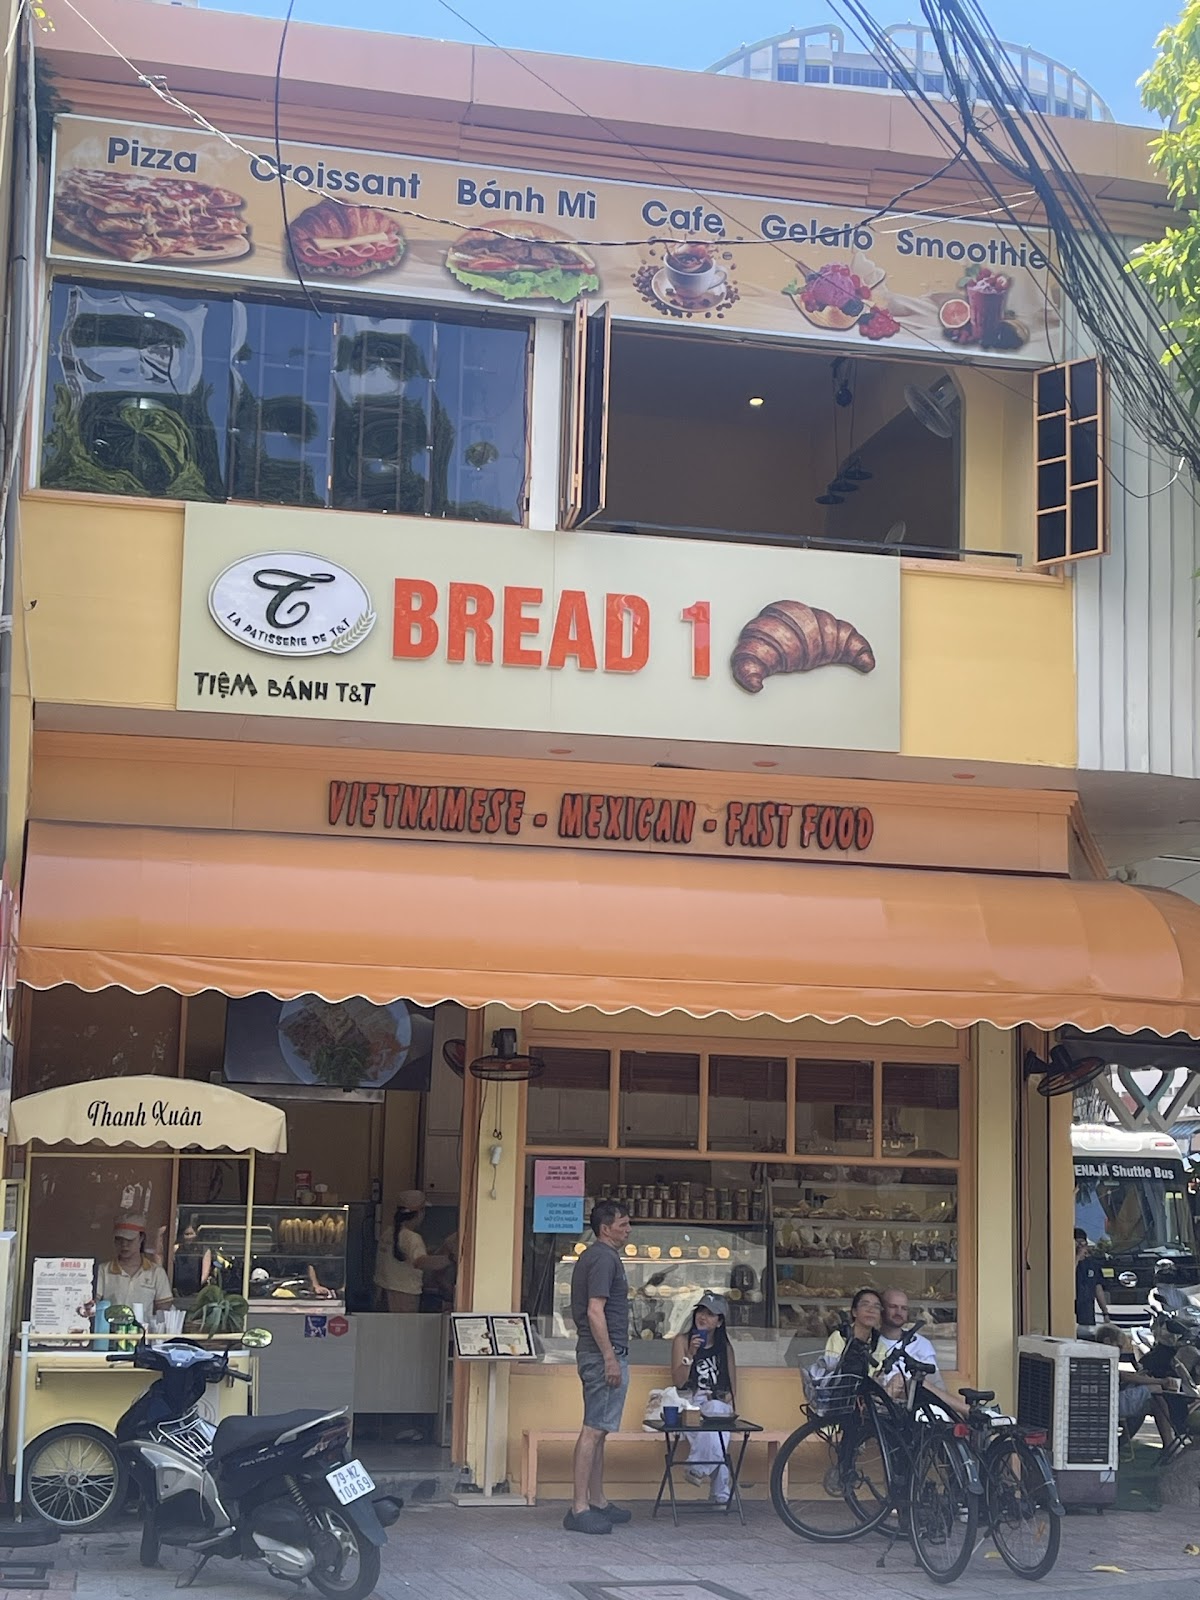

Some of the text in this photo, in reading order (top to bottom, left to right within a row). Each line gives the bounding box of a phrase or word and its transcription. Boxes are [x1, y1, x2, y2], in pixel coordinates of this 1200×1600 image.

[107, 136, 198, 174] Pizza
[249, 155, 421, 199] Croissant
[457, 178, 597, 219] Bánh Mì
[641, 200, 724, 235] Cafe
[760, 214, 874, 251] Gelato
[896, 229, 1047, 270] Smoothie
[227, 612, 351, 647] LA PATISSERIE DE T&T
[392, 577, 711, 679] BREAD 1
[194, 671, 377, 706] TIỆM BÁNH T&T
[328, 781, 526, 835] VIETNAMESE
[558, 793, 696, 843] MEXICAN
[725, 801, 793, 848] FAST
[800, 804, 874, 850] FOOD
[87, 1100, 203, 1127] Thanh Xuân
[1112, 1165, 1151, 1178] Shuttle
[1153, 1166, 1174, 1179] Bus
